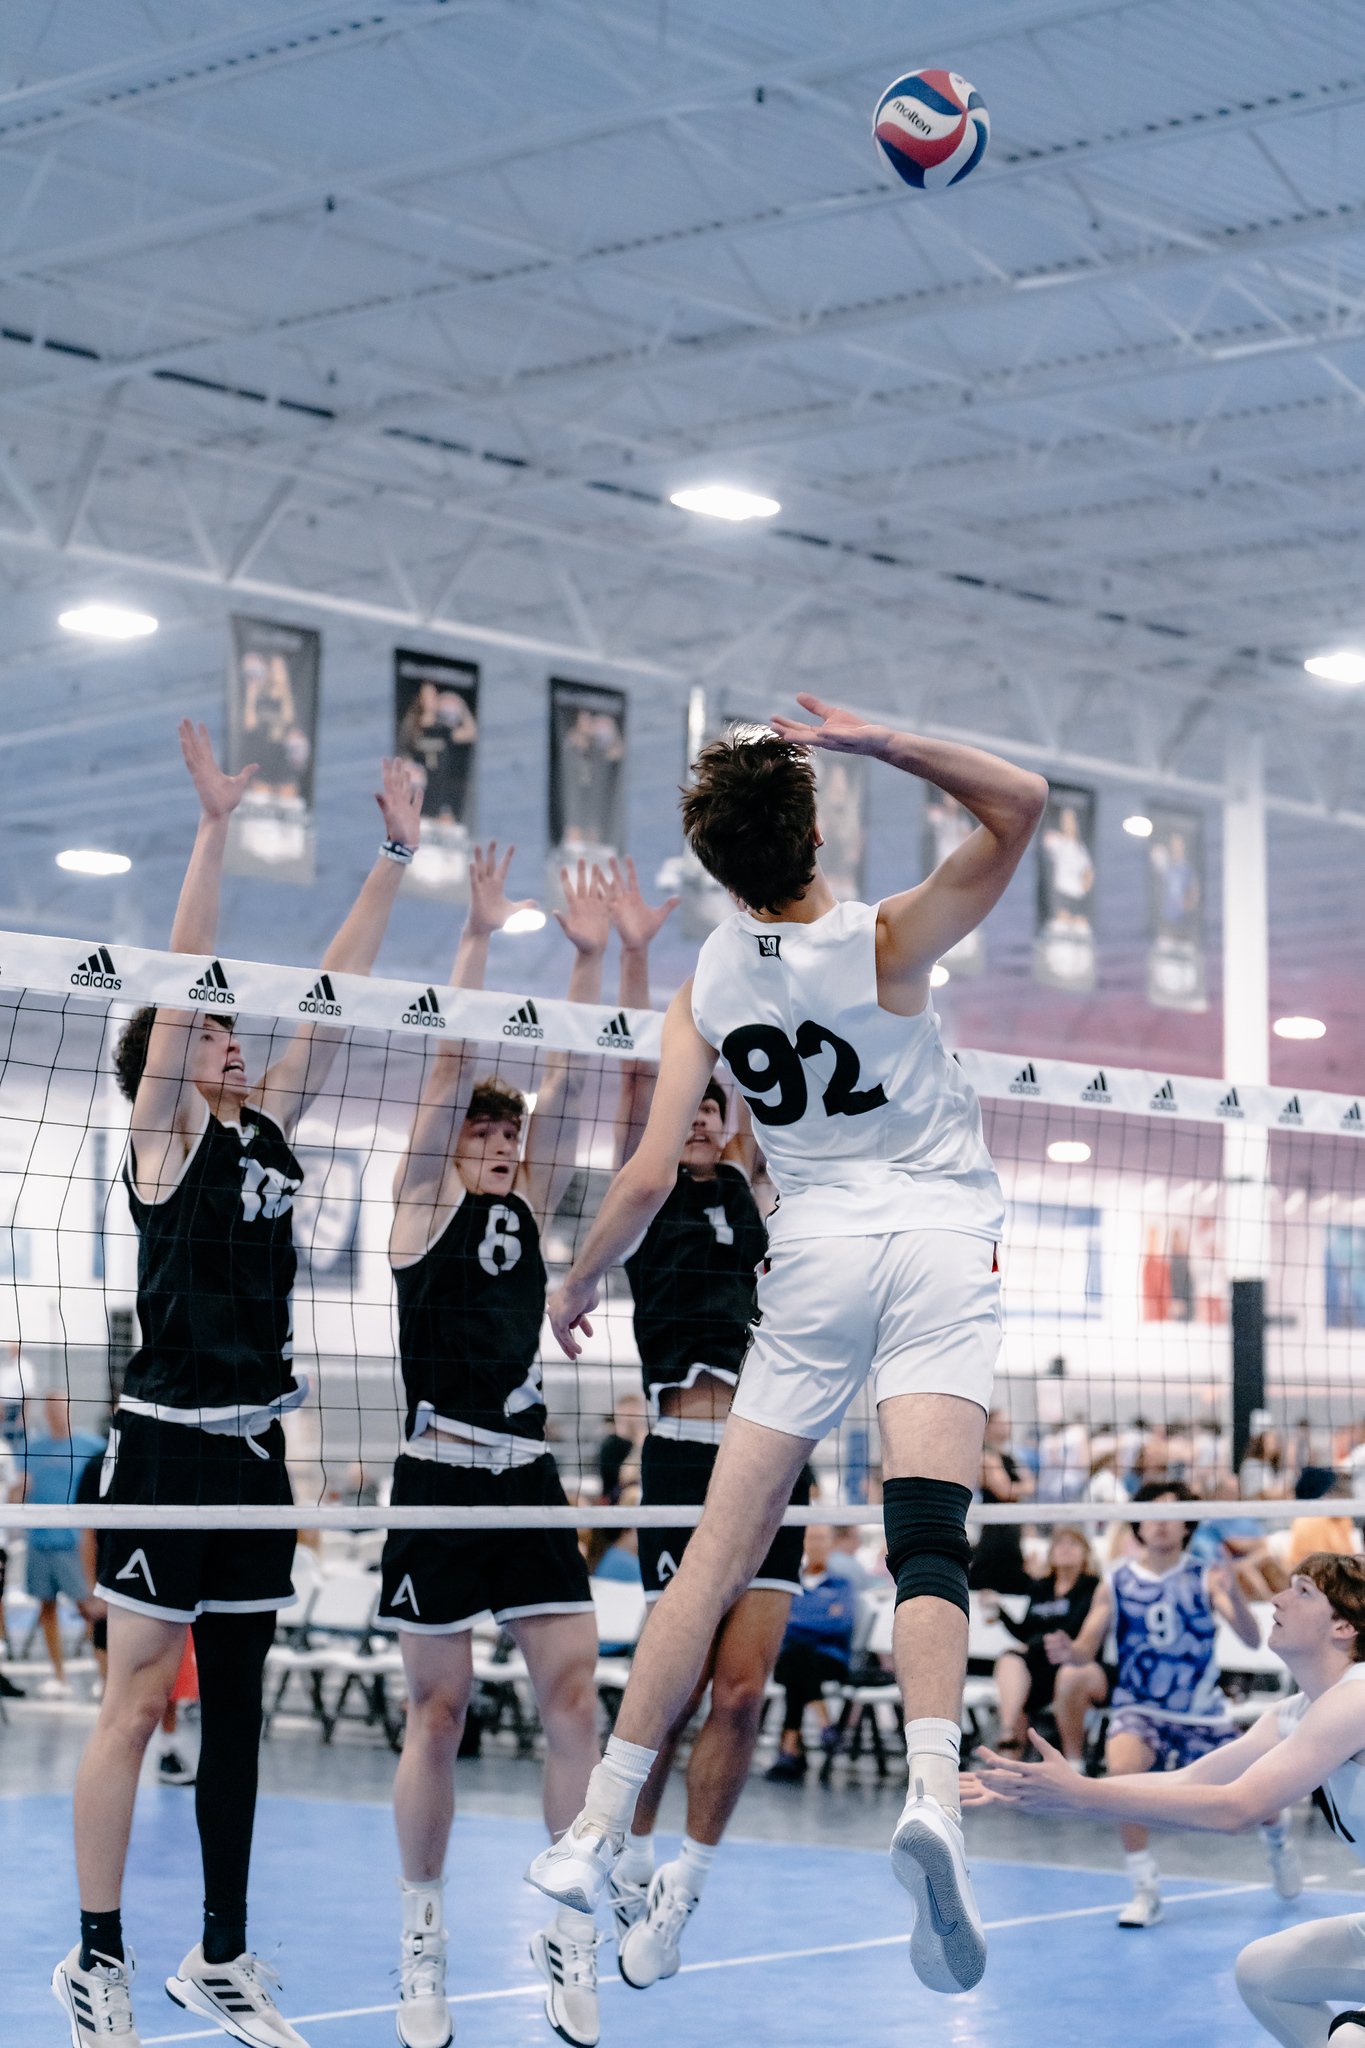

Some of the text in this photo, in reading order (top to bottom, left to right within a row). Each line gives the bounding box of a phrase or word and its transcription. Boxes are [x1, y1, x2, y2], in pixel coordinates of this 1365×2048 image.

[892, 99, 932, 136] molten
[70, 971, 122, 991] adidas
[188, 985, 235, 1005] adidas
[298, 998, 342, 1017] adidas
[401, 1011, 446, 1028] adidas
[503, 1023, 544, 1039] adidas
[597, 1034, 635, 1050] adidas
[721, 1019, 890, 1126] 92
[703, 1204, 734, 1246] 1
[477, 1203, 522, 1277] 6
[1145, 1600, 1178, 1648] 9
